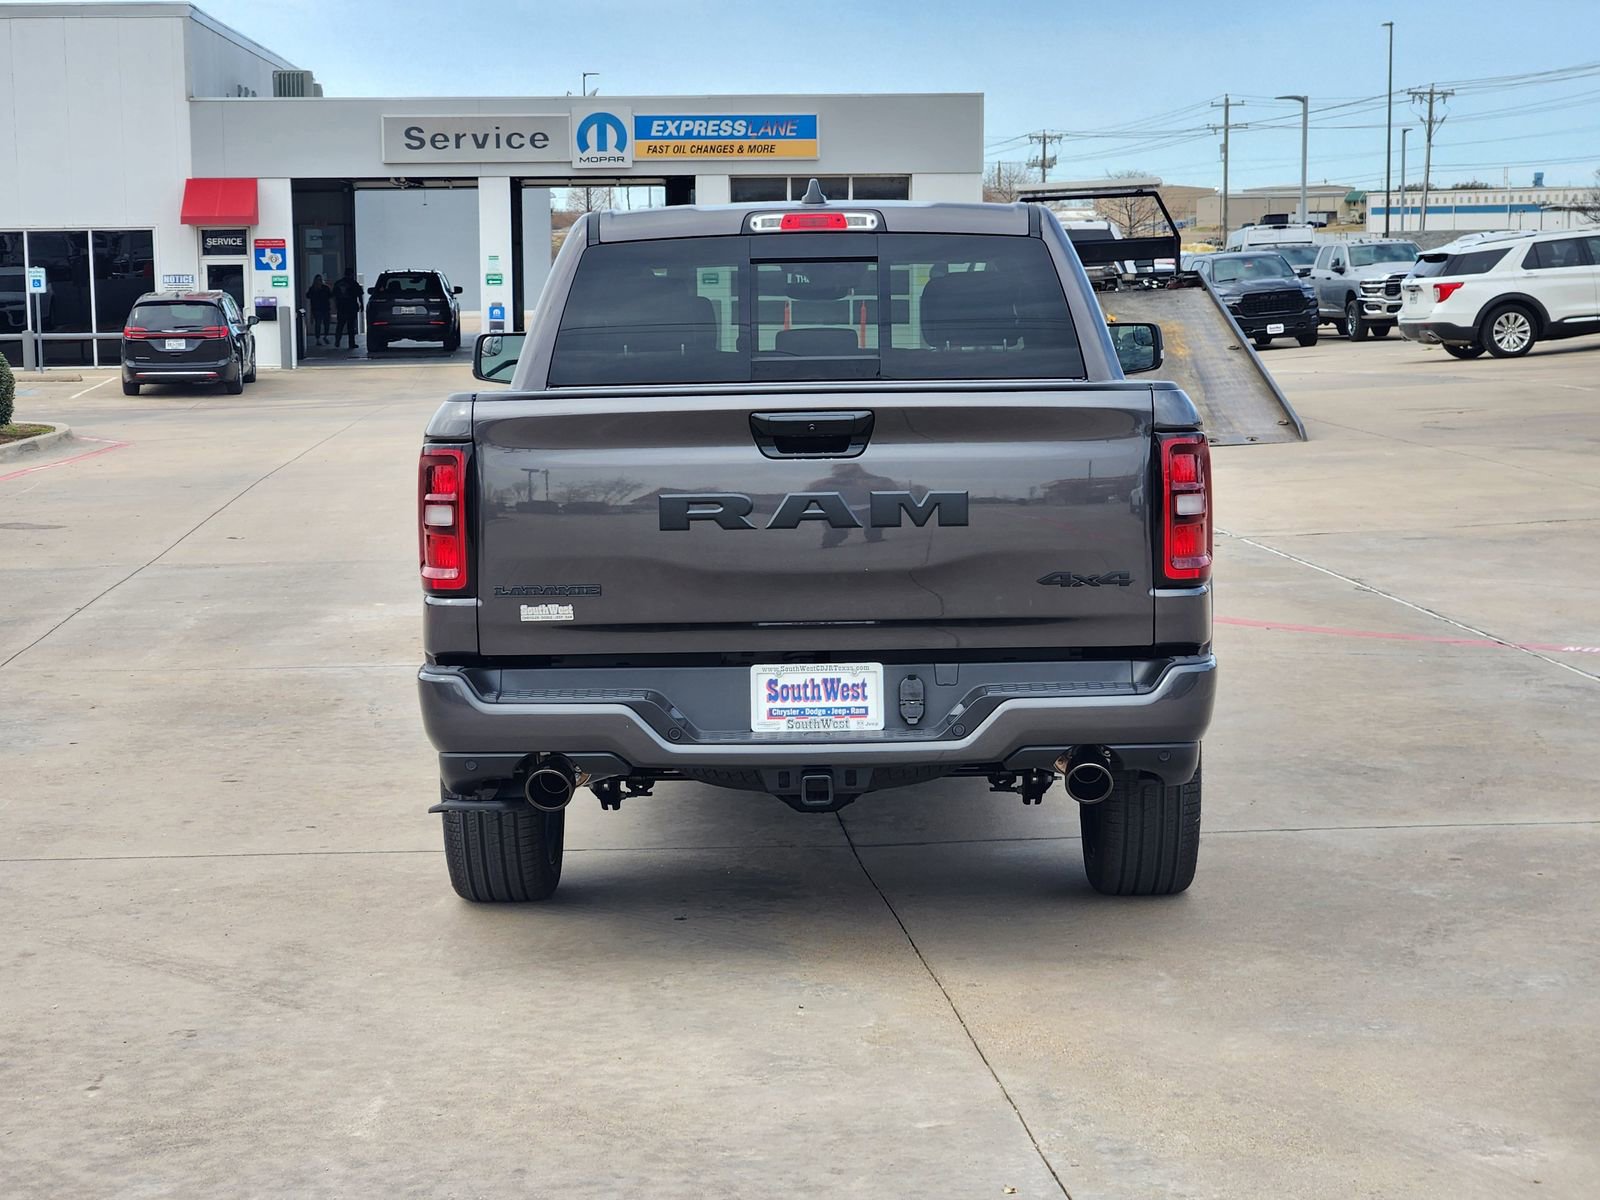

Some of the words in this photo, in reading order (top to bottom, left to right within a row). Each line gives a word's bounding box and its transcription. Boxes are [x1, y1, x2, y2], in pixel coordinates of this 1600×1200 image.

[404, 126, 550, 150] Service
[646, 144, 671, 154] FAST
[672, 144, 687, 154] OIL
[689, 144, 735, 154] CHANGES
[738, 144, 744, 154] &
[747, 144, 776, 154] MORE
[206, 237, 243, 246] SERVICE
[163, 275, 193, 283] NOTICE
[659, 490, 969, 531] RAM
[1037, 571, 1135, 588] 4x4
[494, 584, 602, 597] LARAMIE
[766, 677, 868, 703] SouthWest
[771, 708, 800, 717] Chrysler
[805, 707, 826, 716] Dodge
[830, 707, 847, 716] Jeep
[850, 706, 866, 715] Ram
[786, 718, 850, 730] SouthWest
